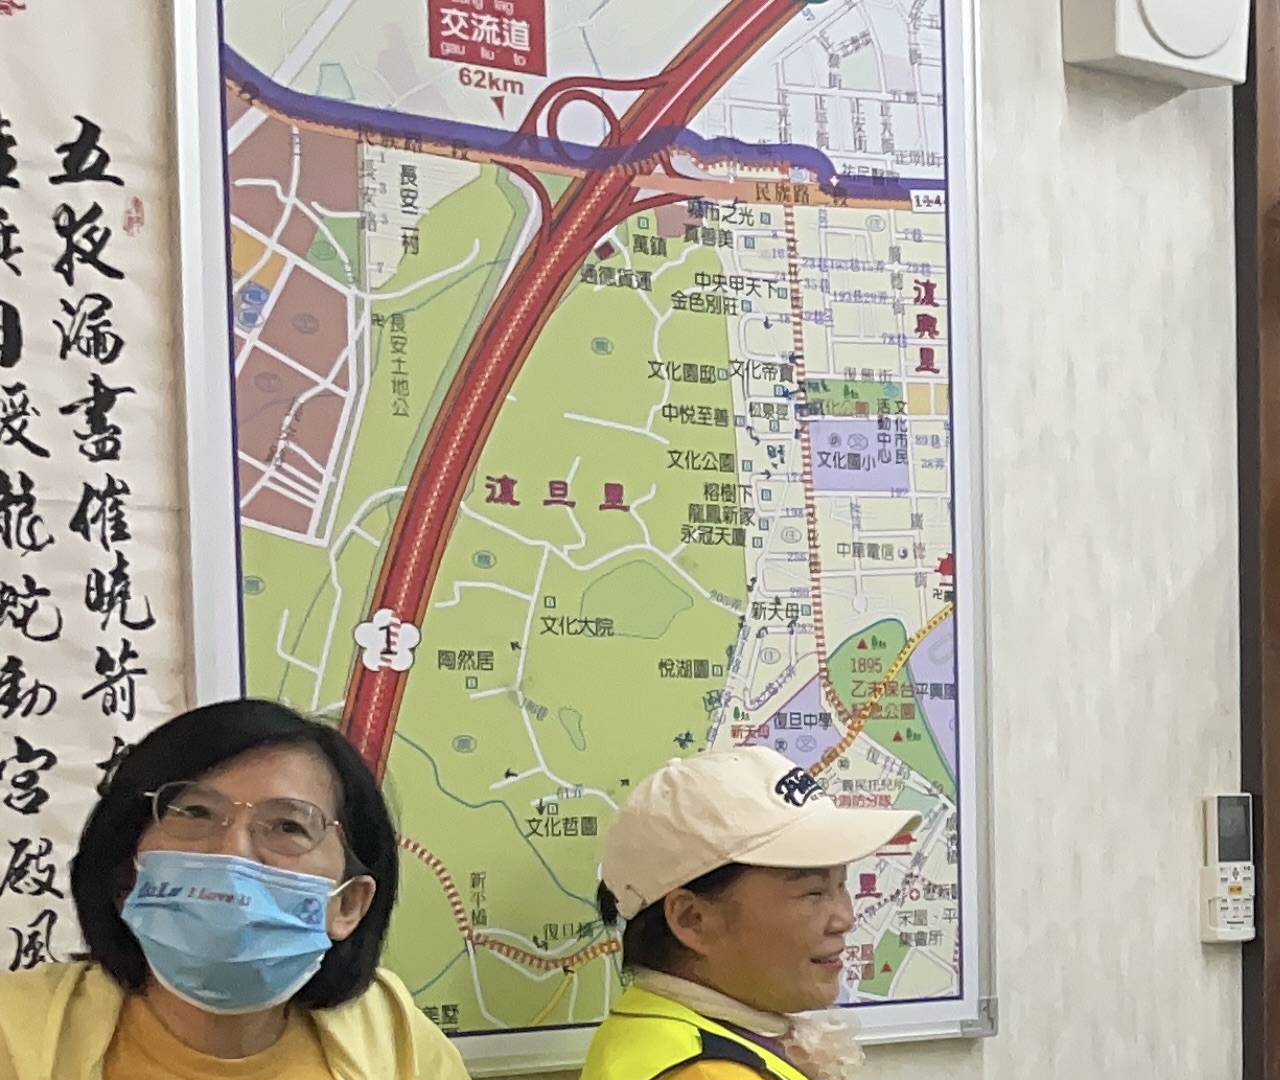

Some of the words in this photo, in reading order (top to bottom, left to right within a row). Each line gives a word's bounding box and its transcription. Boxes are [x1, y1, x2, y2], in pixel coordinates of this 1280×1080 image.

[440, 8, 531, 51] 交流道
[458, 67, 525, 95] 62km
[694, 272, 779, 298] 中央甲天下
[671, 290, 739, 316] 金色別莊
[662, 403, 729, 427] 中悅至善
[667, 450, 735, 473] 文化公園
[817, 451, 876, 472] 文化國小
[704, 482, 753, 504] 榕樹下
[540, 616, 615, 638] 文化大院
[438, 649, 494, 672] 陶然居
[850, 657, 883, 674] 1895
[527, 817, 598, 838] 文化哲園
